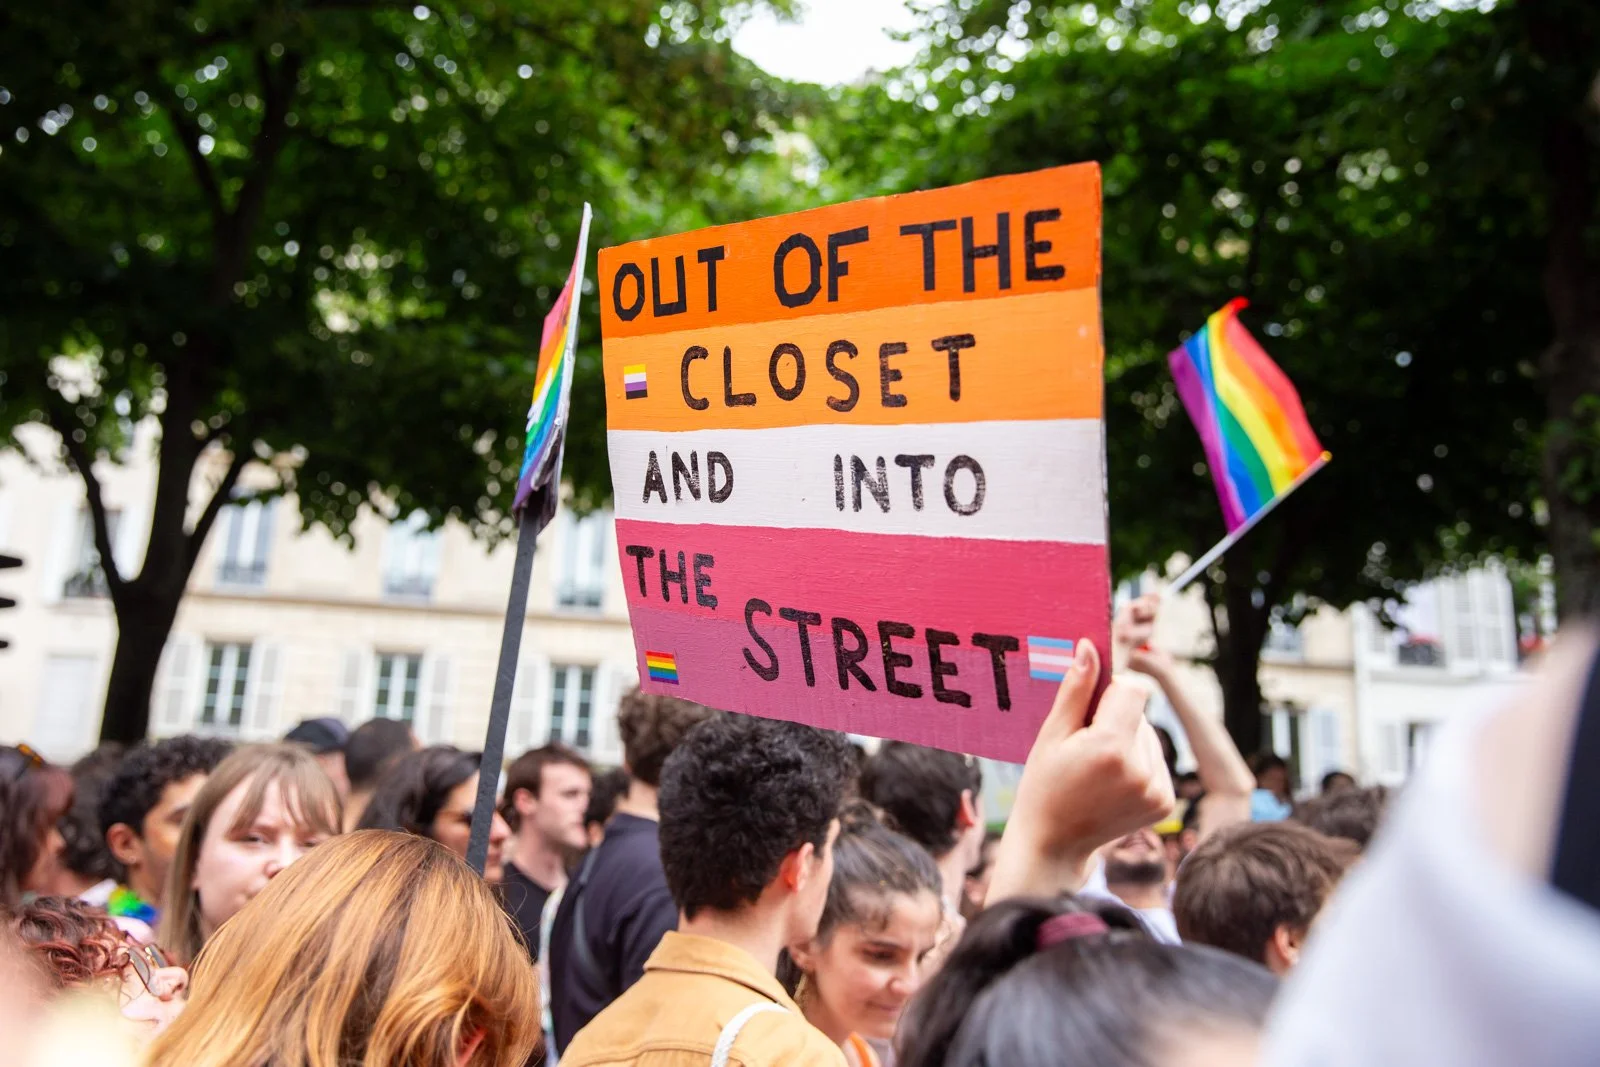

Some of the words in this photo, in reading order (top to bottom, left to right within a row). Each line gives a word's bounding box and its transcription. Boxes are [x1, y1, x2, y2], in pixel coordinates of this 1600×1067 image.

[612, 245, 725, 321] OUT
[773, 226, 870, 309] OF
[900, 208, 1065, 293] THE
[680, 333, 977, 412] CLOSET
[642, 450, 734, 504] AND
[834, 454, 987, 517] INTO
[625, 545, 718, 611] THE
[742, 598, 1021, 712] STREET
